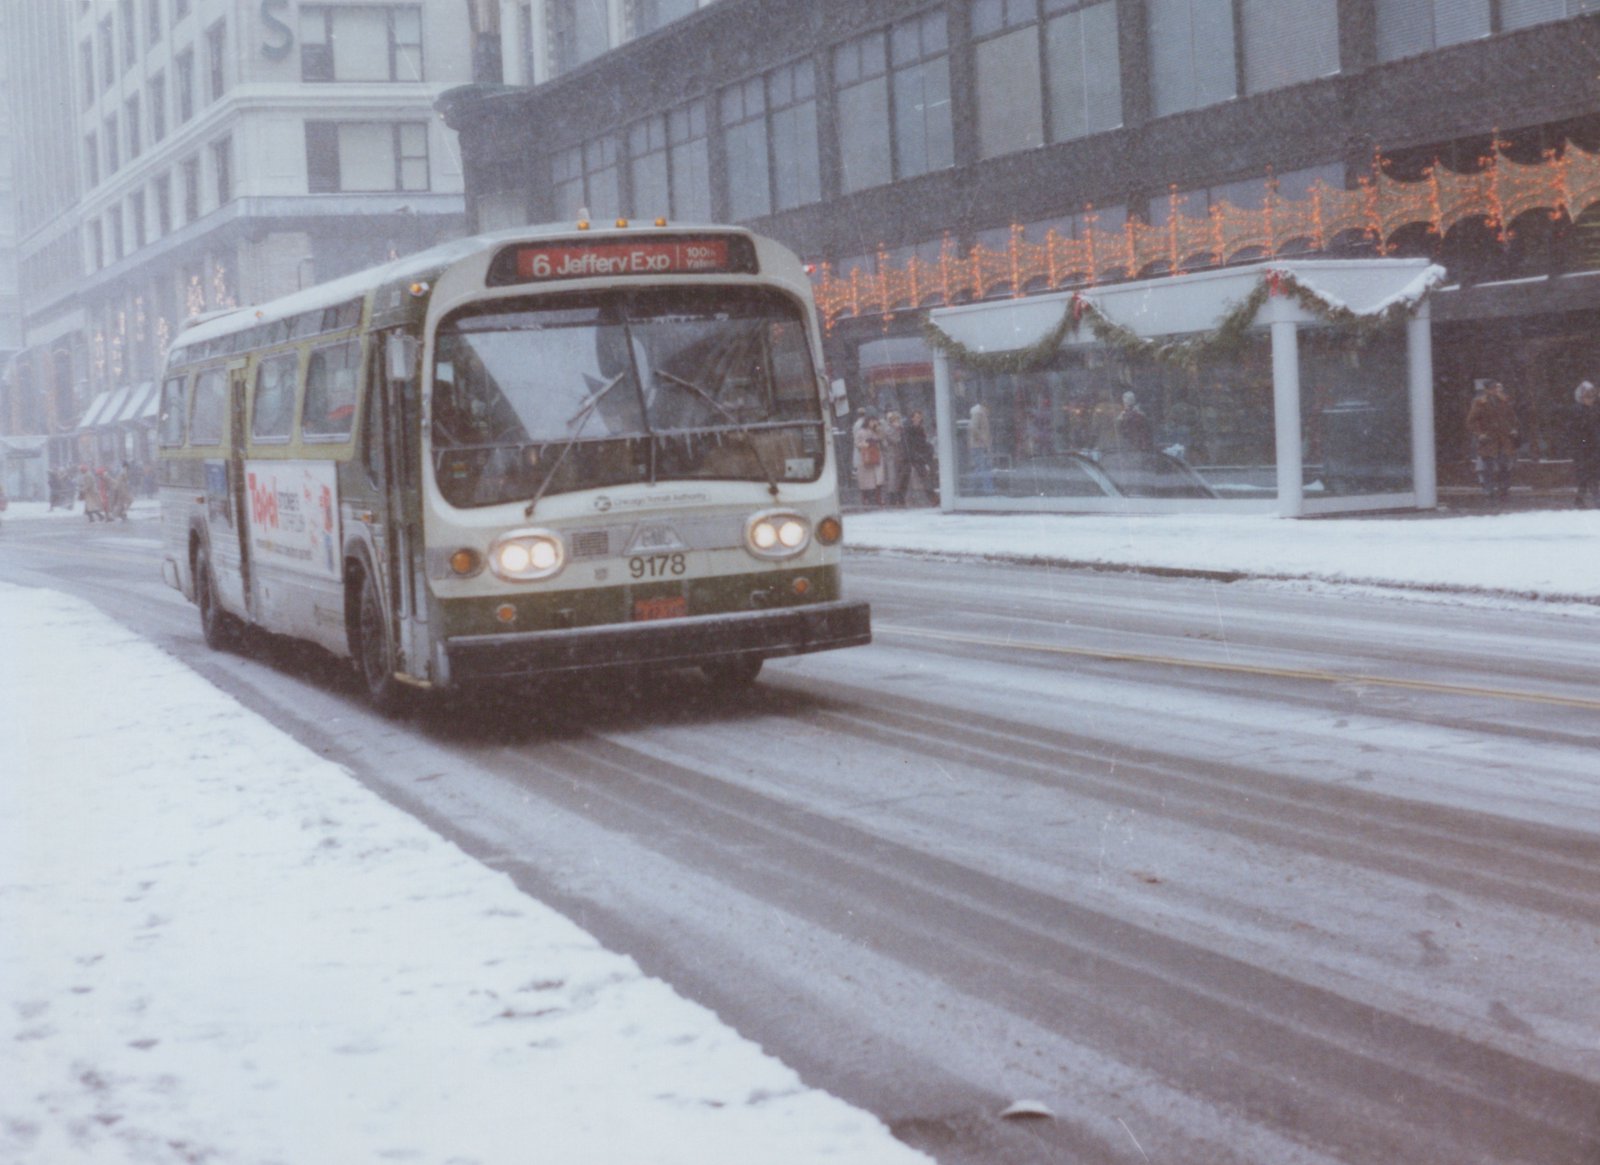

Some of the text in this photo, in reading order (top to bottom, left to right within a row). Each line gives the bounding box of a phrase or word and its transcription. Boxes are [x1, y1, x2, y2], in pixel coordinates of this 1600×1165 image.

[532, 254, 551, 278] 6
[630, 251, 671, 272] Exp
[628, 552, 686, 579] 9178
